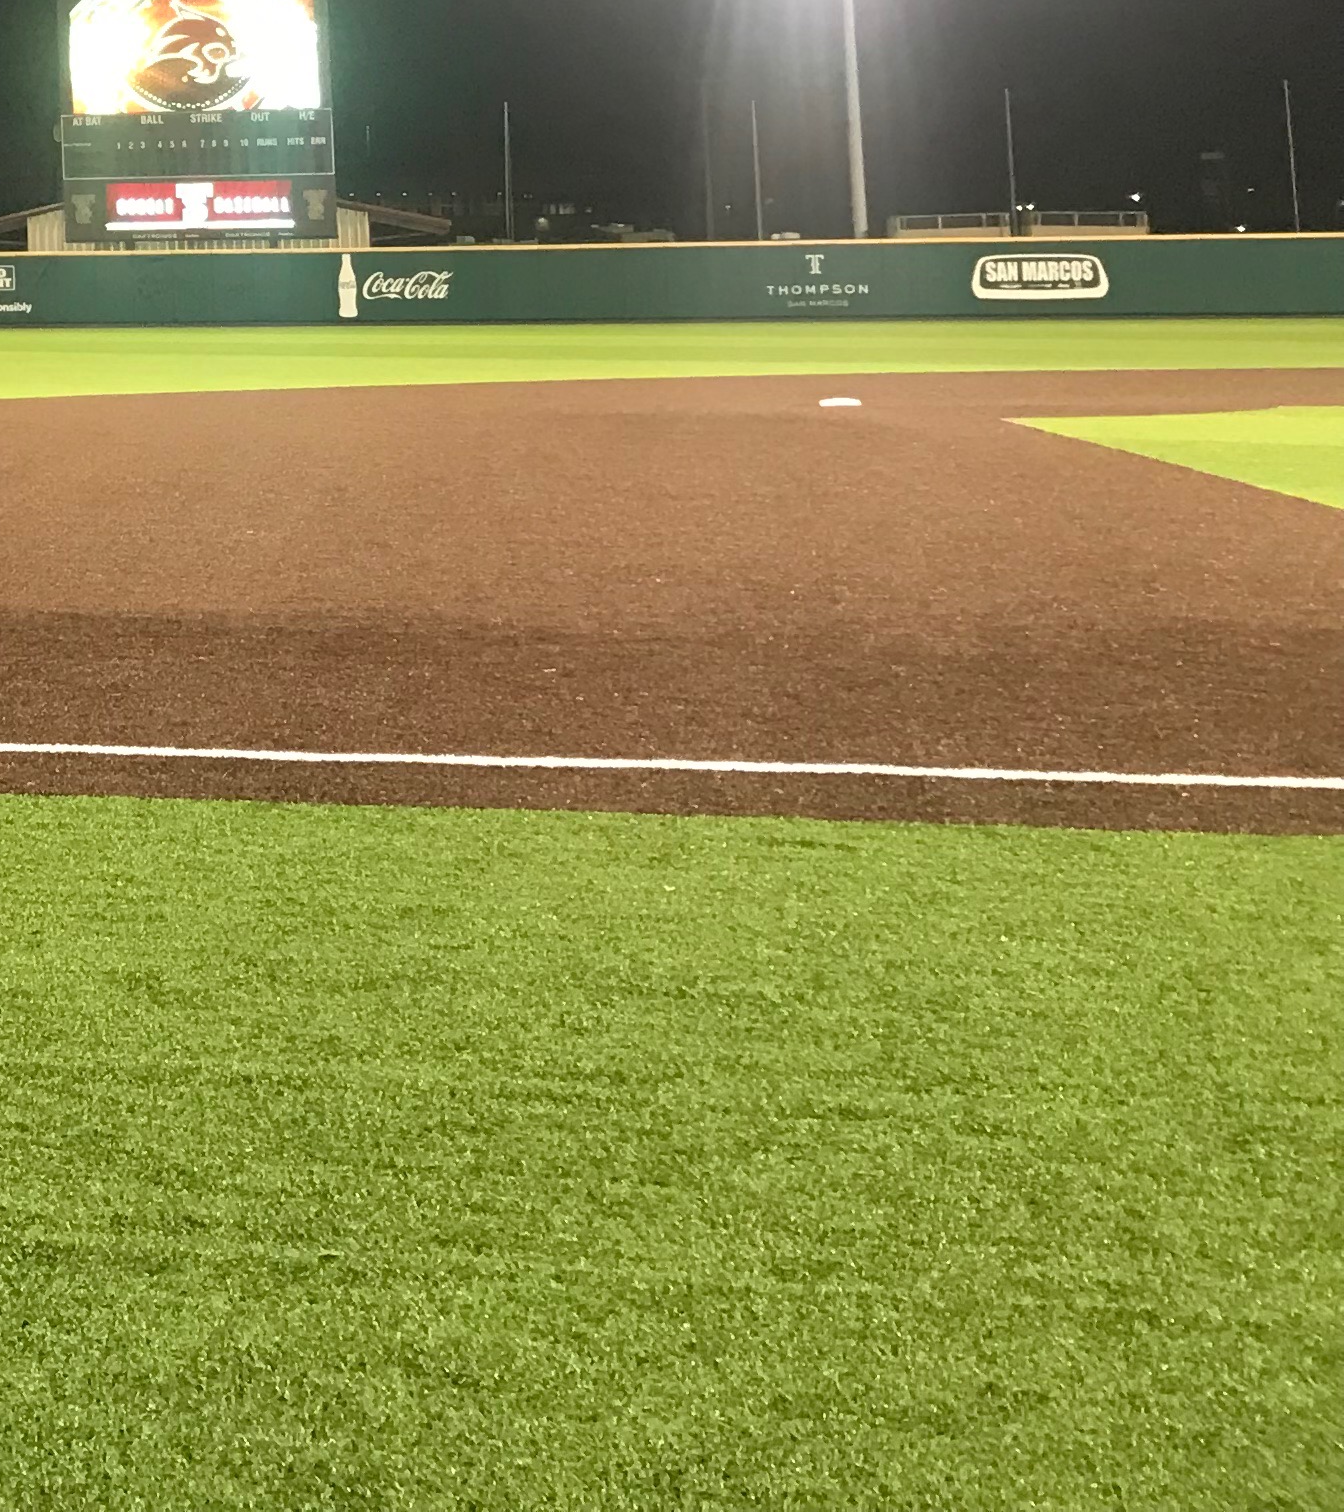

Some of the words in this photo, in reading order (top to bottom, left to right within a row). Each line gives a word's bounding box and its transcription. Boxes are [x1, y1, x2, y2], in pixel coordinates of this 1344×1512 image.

[73, 117, 84, 127] AT
[85, 116, 102, 126] BAT
[140, 115, 165, 125] BALL
[189, 113, 223, 123] STRIKE
[250, 112, 271, 122] OUT
[298, 110, 315, 121] H/E
[128, 141, 134, 150] 2
[140, 141, 146, 149] 3
[157, 140, 163, 149] 4
[200, 139, 205, 148] 7
[240, 138, 249, 147] 10
[286, 137, 304, 146] HITS
[805, 254, 825, 274] T
[985, 261, 1018, 282] SAN
[1021, 260, 1094, 282] MARCOS
[362, 271, 454, 300] Coca-Cola
[766, 284, 869, 295] THOMPSON
